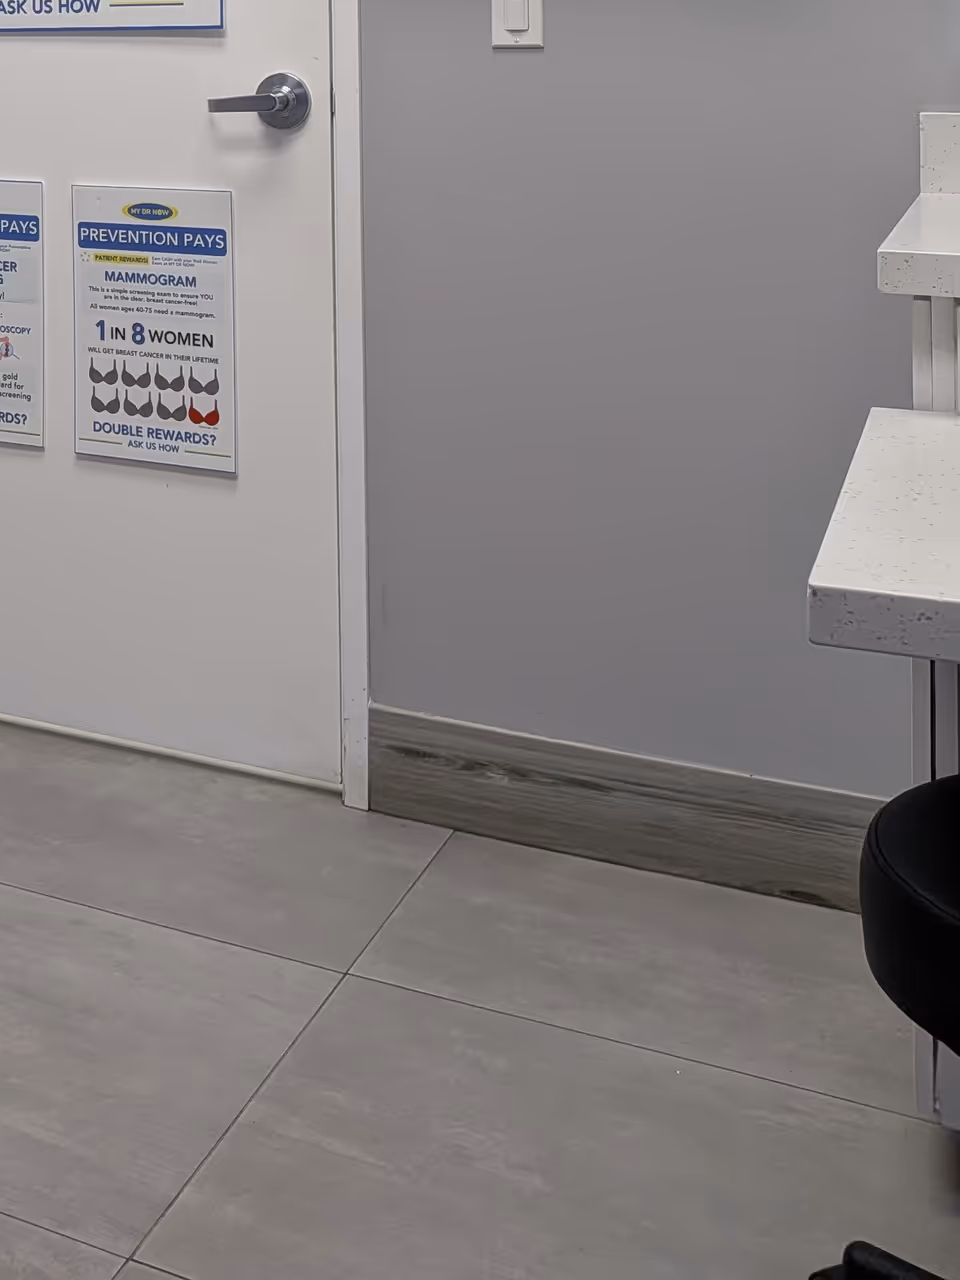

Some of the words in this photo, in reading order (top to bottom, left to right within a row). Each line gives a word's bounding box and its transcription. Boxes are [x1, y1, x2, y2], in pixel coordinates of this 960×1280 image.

[33, 0, 53, 13] US
[1, 221, 37, 234] PAYS
[81, 228, 178, 246] PREVENTION
[184, 234, 224, 248] PAYS
[105, 271, 196, 288] MAMMOGRAM
[129, 289, 155, 297] screening
[96, 320, 105, 341] 1
[111, 327, 125, 340] IN
[132, 322, 145, 345] 8
[149, 330, 213, 348] WOMEN
[116, 349, 137, 357] BREAST
[3, 372, 18, 381] gold
[14, 382, 24, 390] for
[0, 391, 31, 401] screening
[93, 421, 143, 437] DOUBLE
[147, 428, 216, 446] REWARDS?
[128, 440, 143, 448] ASK
[146, 442, 156, 450] US
[159, 444, 179, 453] HOW
